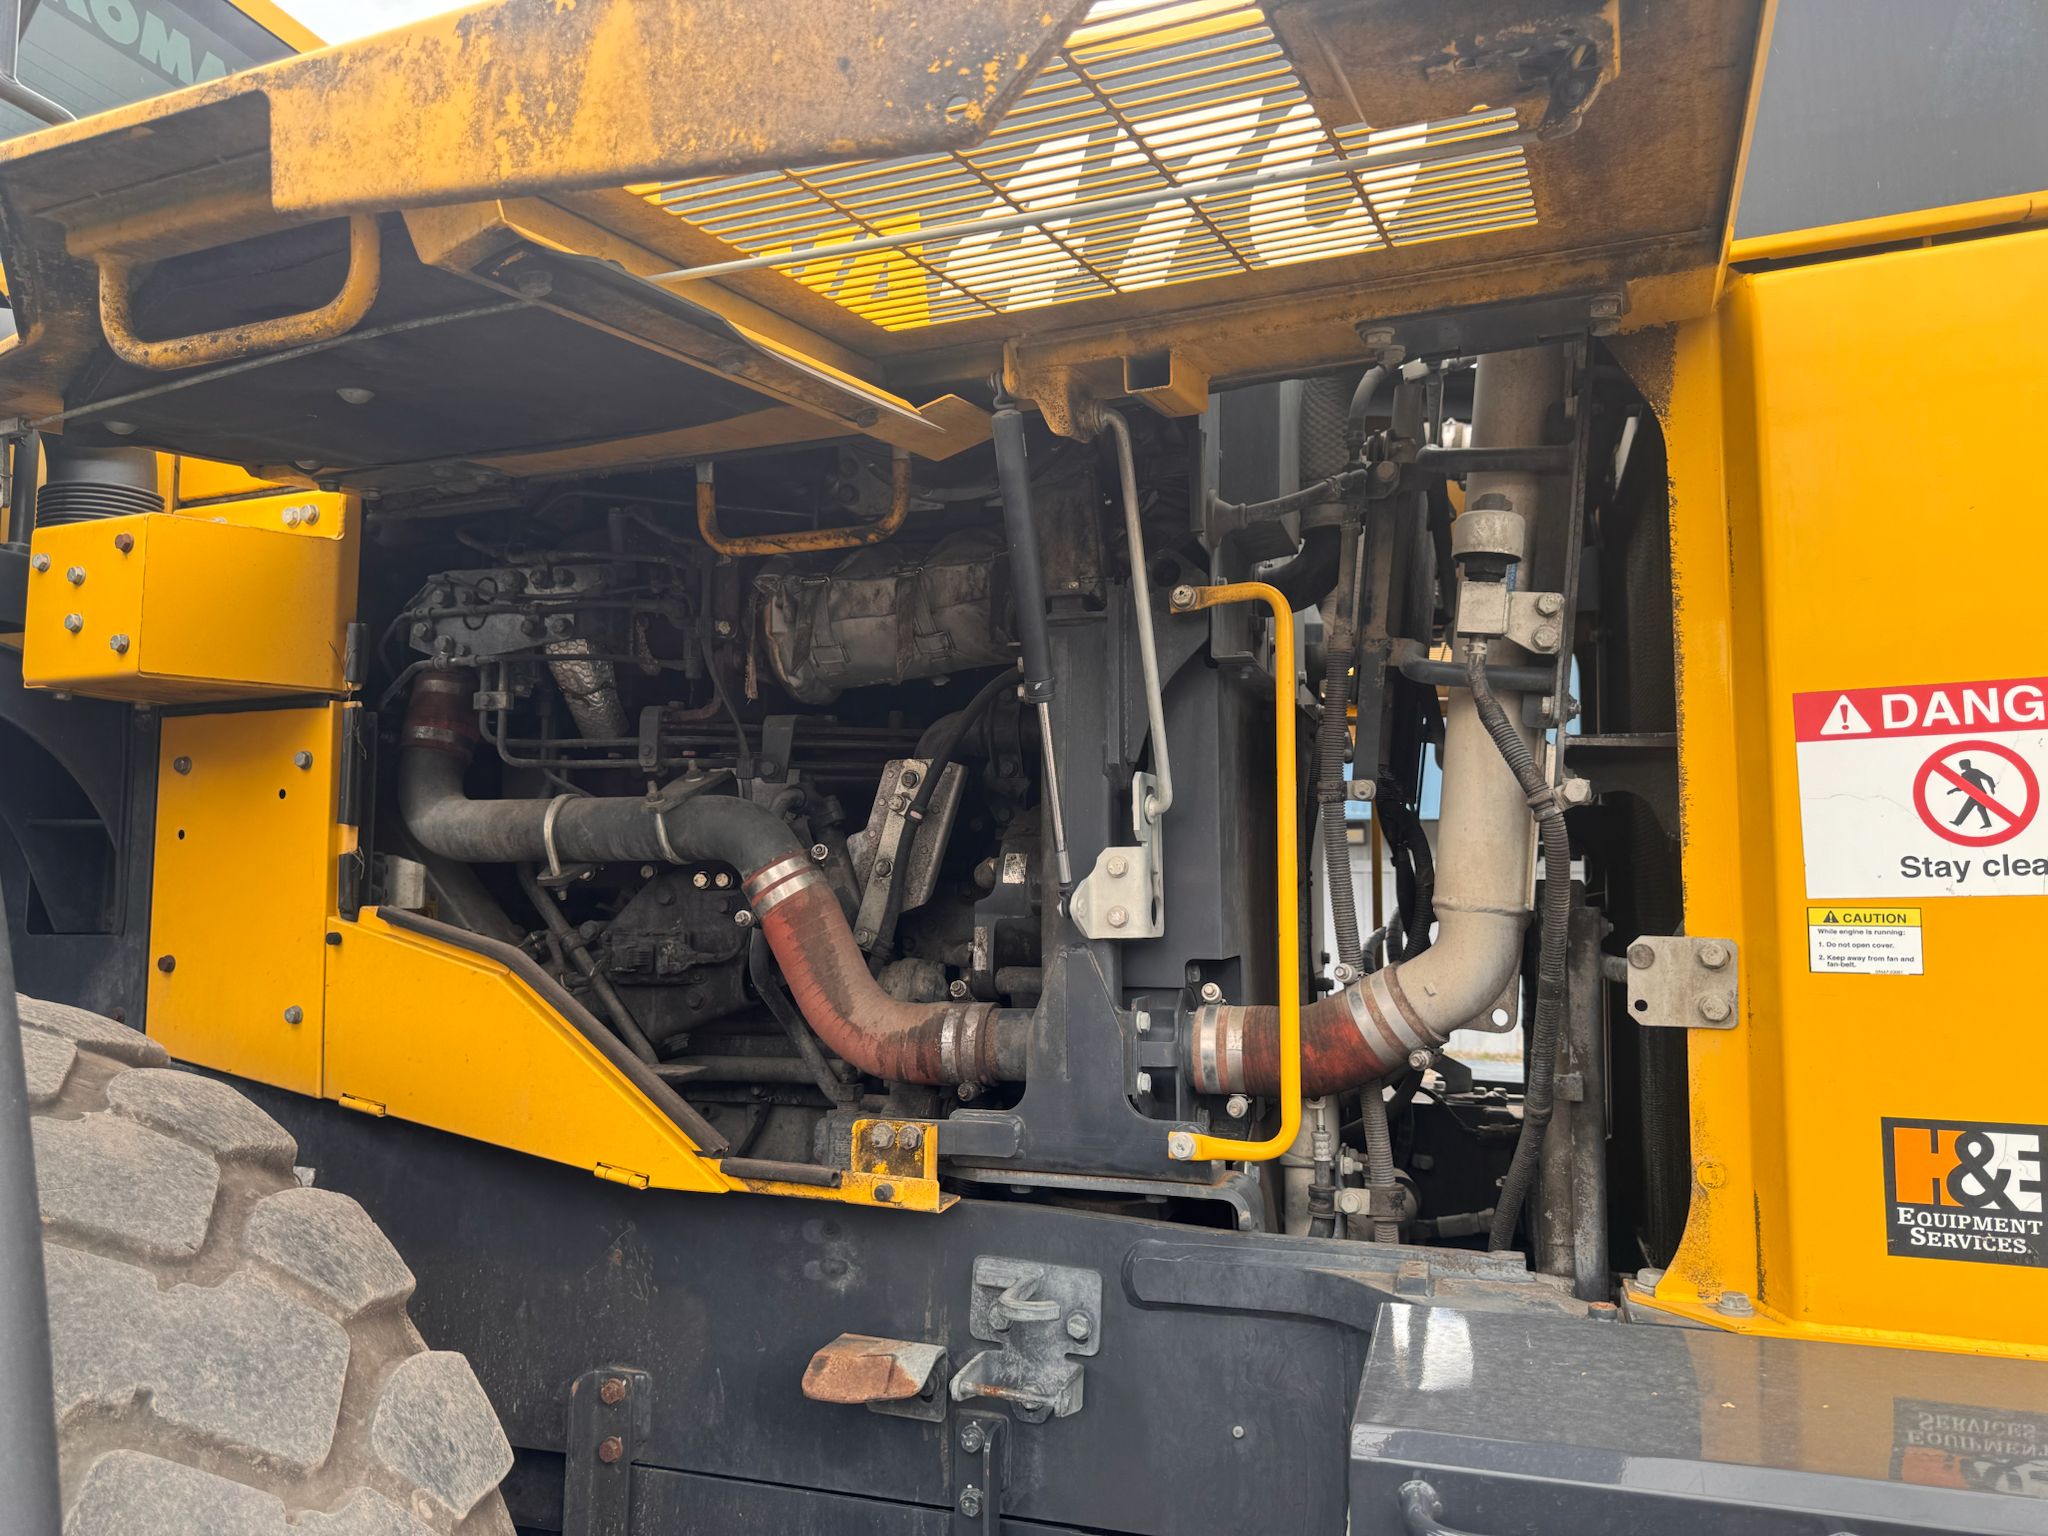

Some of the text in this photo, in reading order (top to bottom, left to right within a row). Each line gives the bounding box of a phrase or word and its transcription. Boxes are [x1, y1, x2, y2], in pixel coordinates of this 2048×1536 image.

[1881, 685, 2046, 729] DANG
[1900, 854, 2048, 883] Stay clea
[1839, 928, 1864, 936] engine
[1843, 913, 1907, 924] CAUTION
[1826, 954, 1846, 962] Keep
[1900, 955, 1915, 963] and
[1893, 1126, 2043, 1213] H&E
[1896, 1206, 2044, 1236] EQUIPMENT
